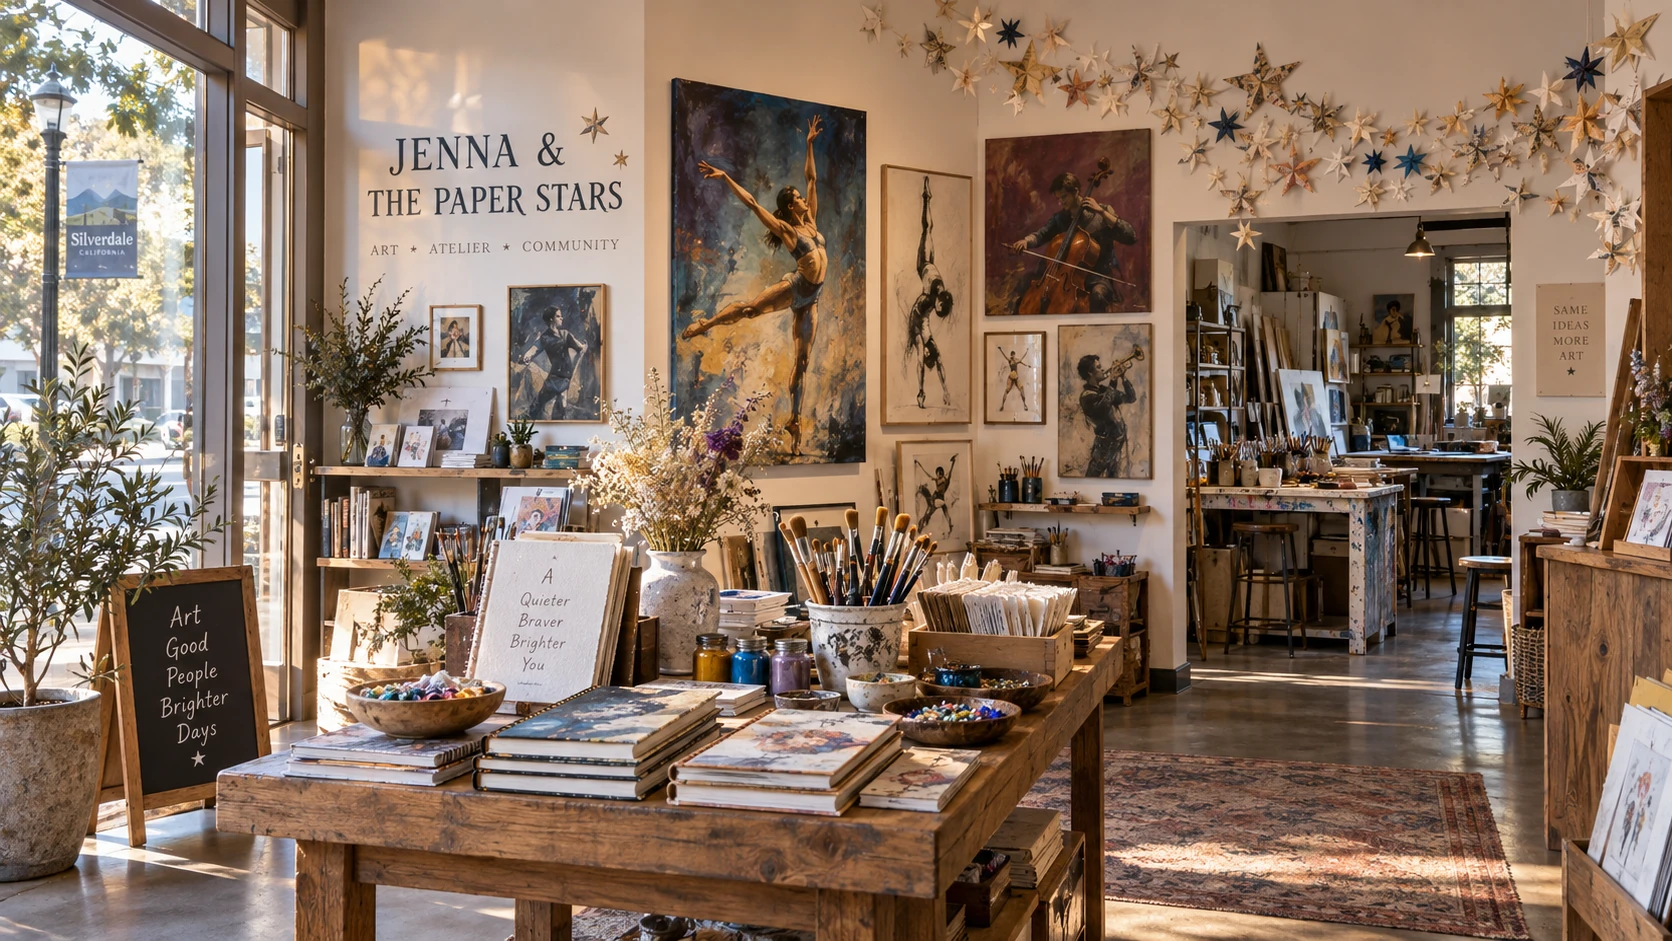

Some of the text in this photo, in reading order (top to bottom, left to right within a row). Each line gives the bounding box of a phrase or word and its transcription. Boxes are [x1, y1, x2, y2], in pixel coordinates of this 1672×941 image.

[389, 132, 565, 176] JENNA &
[367, 181, 623, 217] THE PAPER STARS
[70, 231, 134, 246] Silverdale
[370, 239, 620, 256] ART ATELIER COMMUNITY
[1553, 305, 1588, 315] SAME
[1553, 320, 1589, 330] IDEAS
[1553, 336, 1589, 345] MORE
[1559, 351, 1584, 360] ART
[541, 567, 553, 584] A
[520, 591, 571, 608] Quieter
[170, 604, 201, 629] Art
[518, 612, 563, 628] Braver
[166, 631, 209, 660] Good
[510, 633, 566, 654] Brighter
[522, 656, 545, 672] You
[166, 661, 218, 689] People
[160, 690, 229, 720] Brighter
[176, 722, 217, 746] Days
